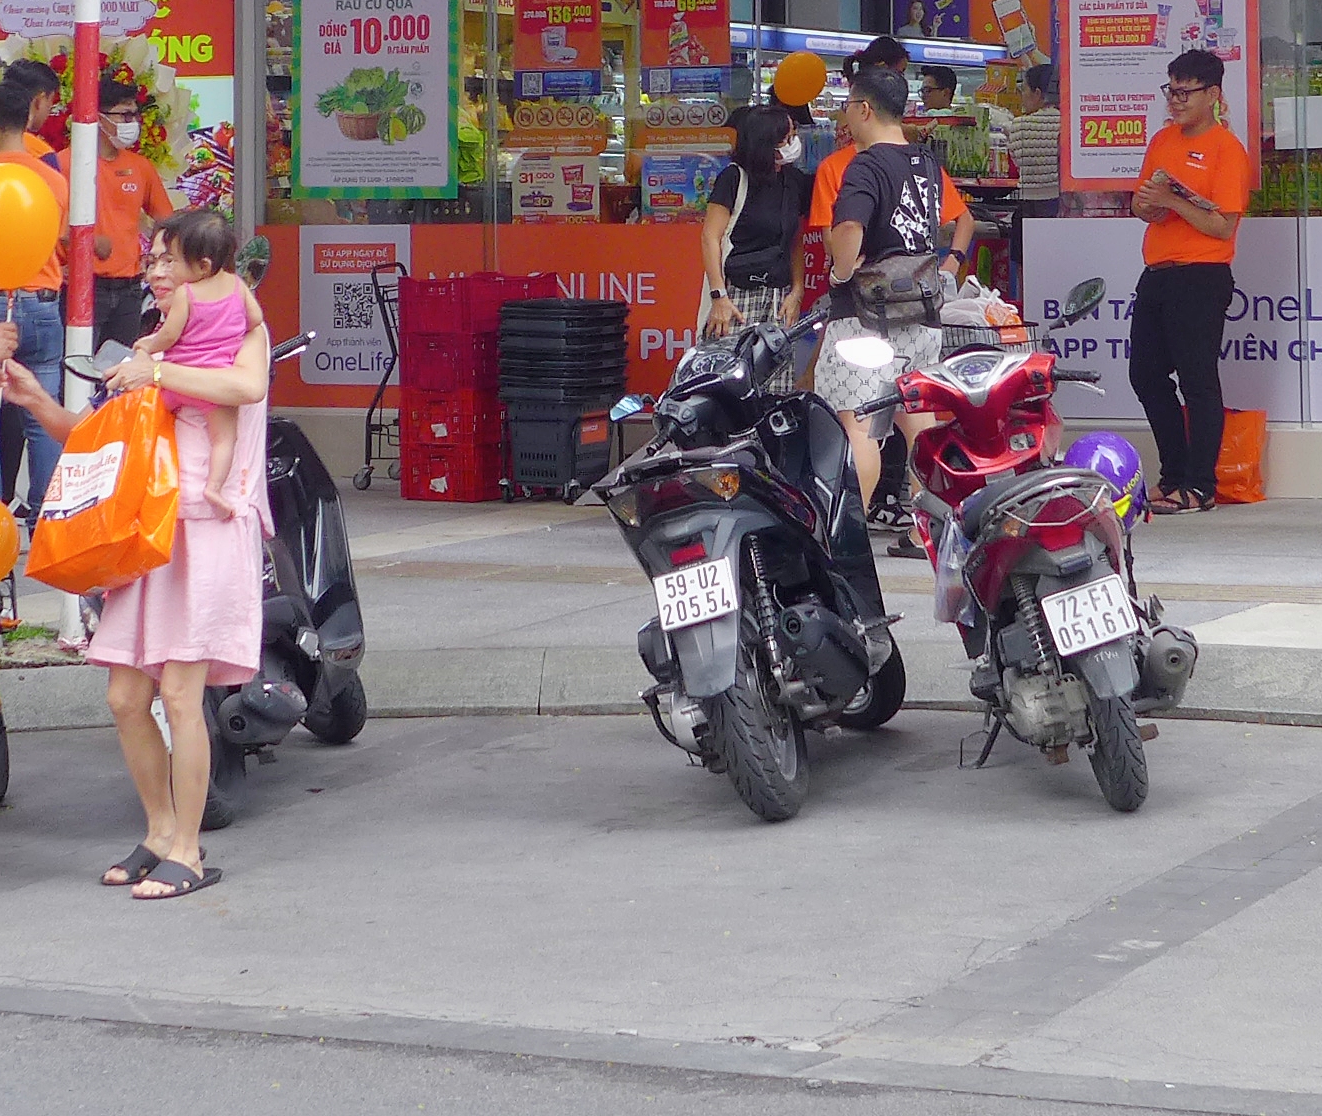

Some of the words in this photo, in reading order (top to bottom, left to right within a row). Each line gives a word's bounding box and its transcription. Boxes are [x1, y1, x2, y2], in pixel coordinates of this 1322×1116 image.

[335, 0, 361, 11] RAU
[318, 18, 348, 37] ĐỒNG
[350, 14, 431, 55] 10.000
[323, 39, 342, 55] GIÁ
[1084, 120, 1143, 144] 24.000
[336, 249, 352, 258] APP
[315, 351, 396, 372] OneLife
[664, 564, 721, 599] 59-U2
[662, 587, 732, 626] 205.54
[1055, 584, 1114, 623] 72-F1
[1058, 606, 1131, 649] 051.61
